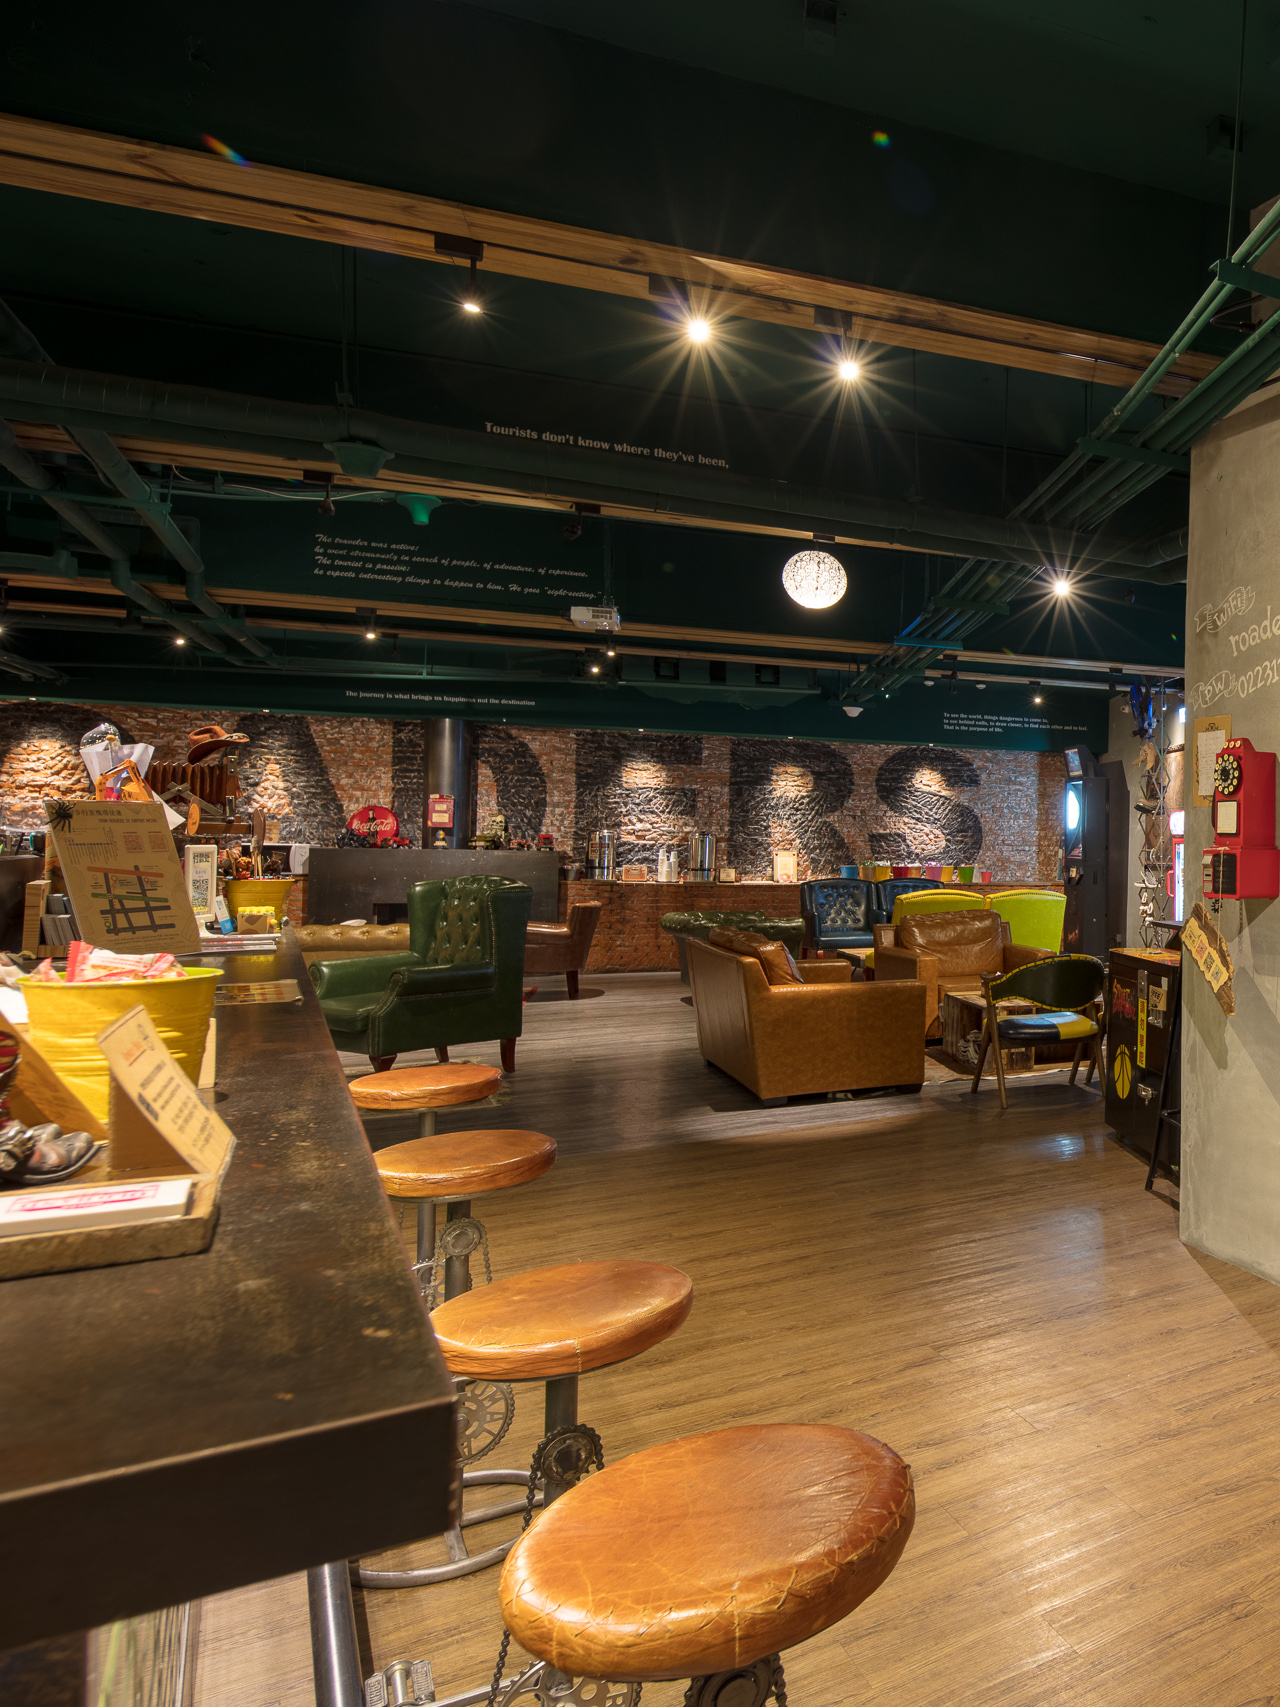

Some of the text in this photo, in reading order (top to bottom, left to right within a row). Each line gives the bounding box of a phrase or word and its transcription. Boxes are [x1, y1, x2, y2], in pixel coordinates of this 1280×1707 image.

[485, 421, 538, 439] Tourists
[578, 436, 610, 450] know
[614, 442, 650, 456] where
[698, 454, 729, 469] been,
[315, 533, 332, 543] The
[334, 537, 368, 546] traveler
[314, 545, 324, 553] he
[411, 556, 438, 564] search
[440, 558, 450, 566] of
[483, 562, 493, 570] of
[538, 567, 547, 575] of
[315, 555, 332, 565] The
[334, 559, 363, 568] tourist
[313, 567, 324, 575] he
[326, 569, 356, 578] expects
[358, 572, 403, 583] interesting
[405, 575, 430, 586] things
[444, 578, 473, 588] happen
[486, 581, 505, 591] him.
[508, 583, 522, 592] He
[411, 693, 433, 701] brings
[443, 695, 476, 703] happiness
[501, 698, 536, 706] destination
